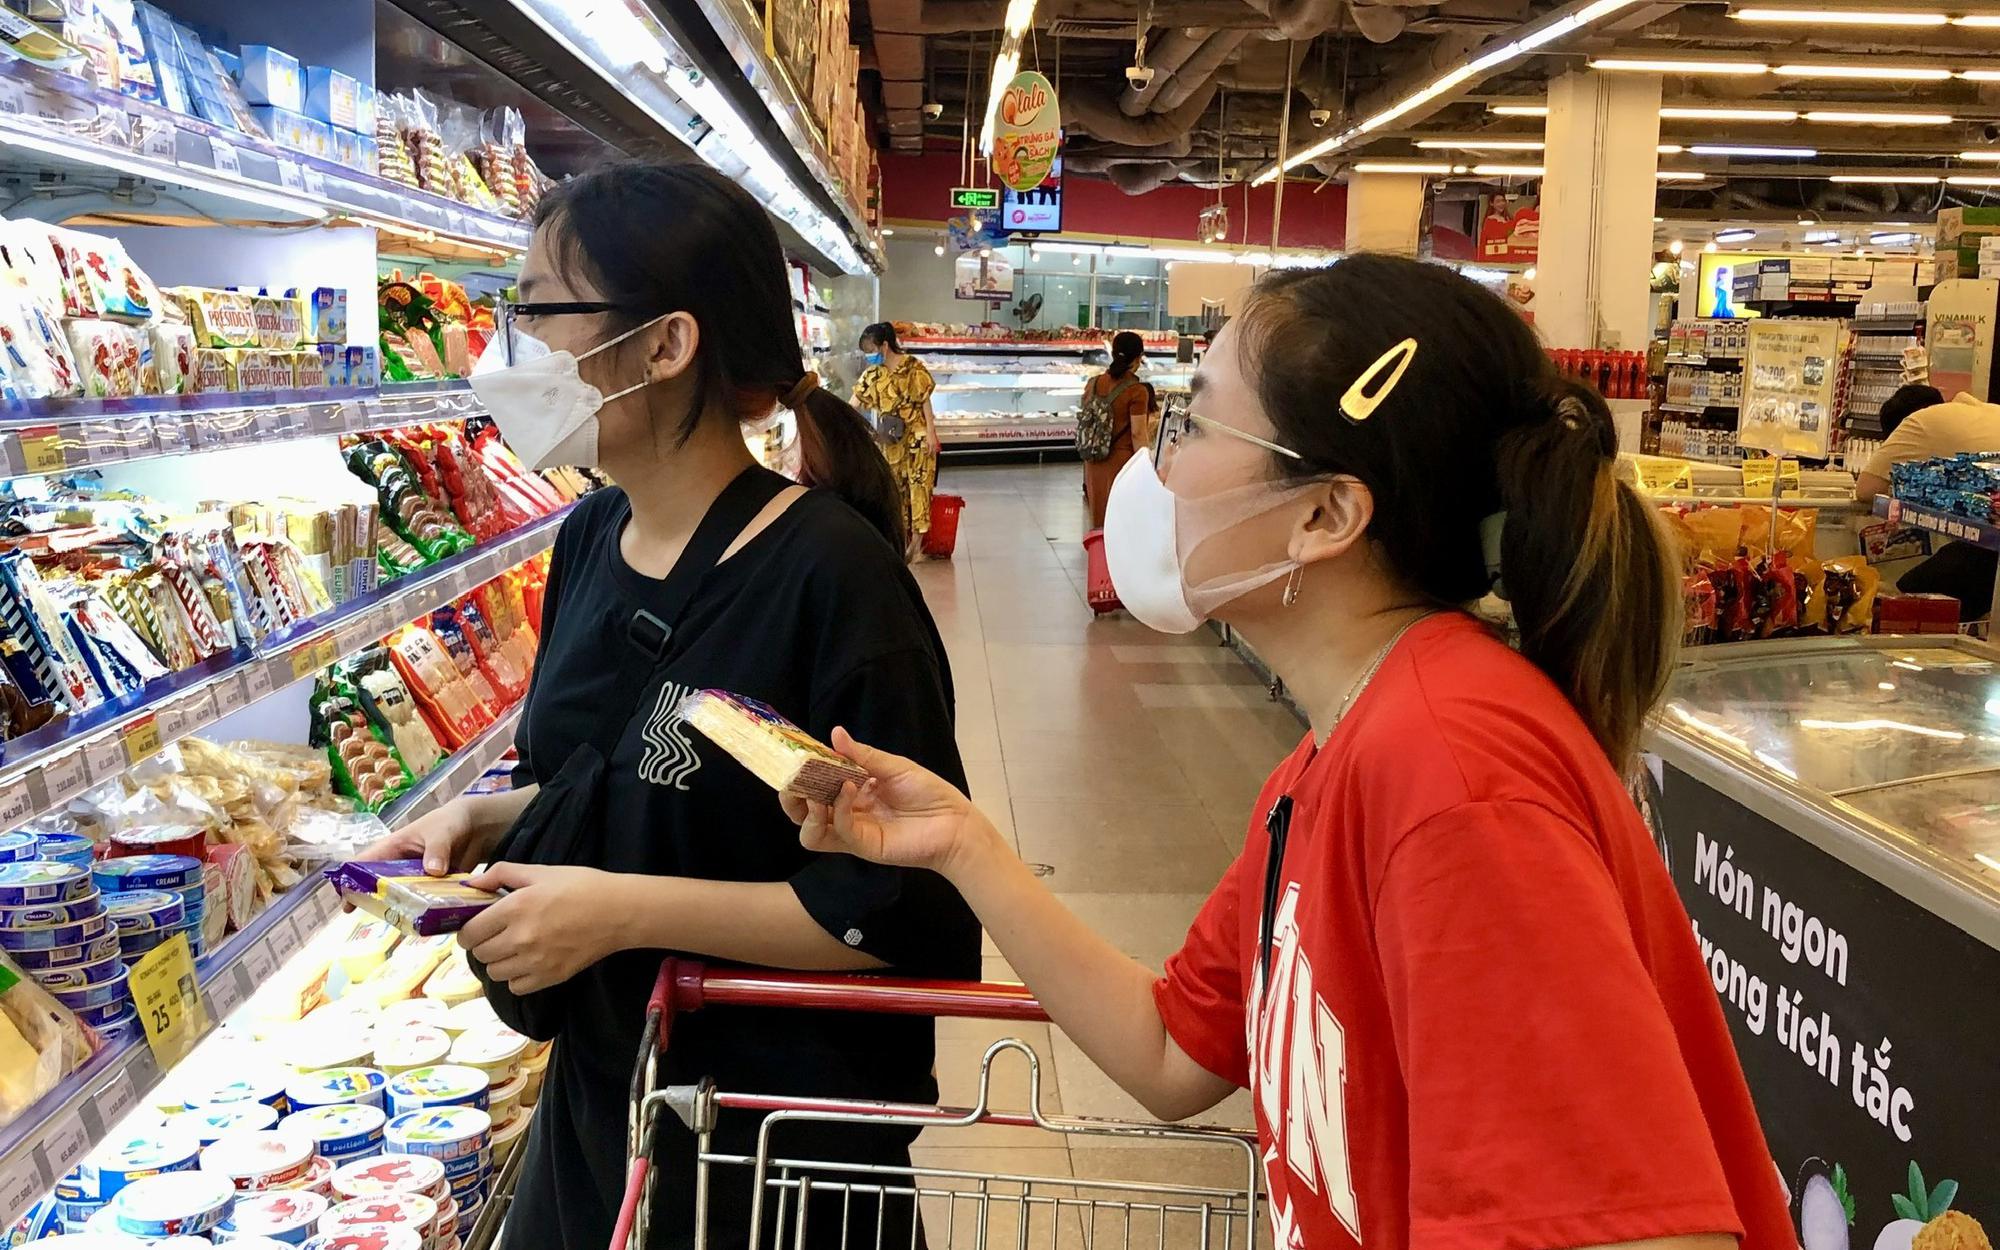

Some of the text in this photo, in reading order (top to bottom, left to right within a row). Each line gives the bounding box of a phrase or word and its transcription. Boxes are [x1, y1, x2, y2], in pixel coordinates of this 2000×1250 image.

[1935, 313, 1986, 324] VINAMILK
[155, 876, 180, 887] CREAMY
[1694, 831, 1849, 987] Món ngon
[151, 1003, 170, 1035] 25
[1776, 990, 1840, 1087] tích
[1851, 1036, 1915, 1142] tắc
